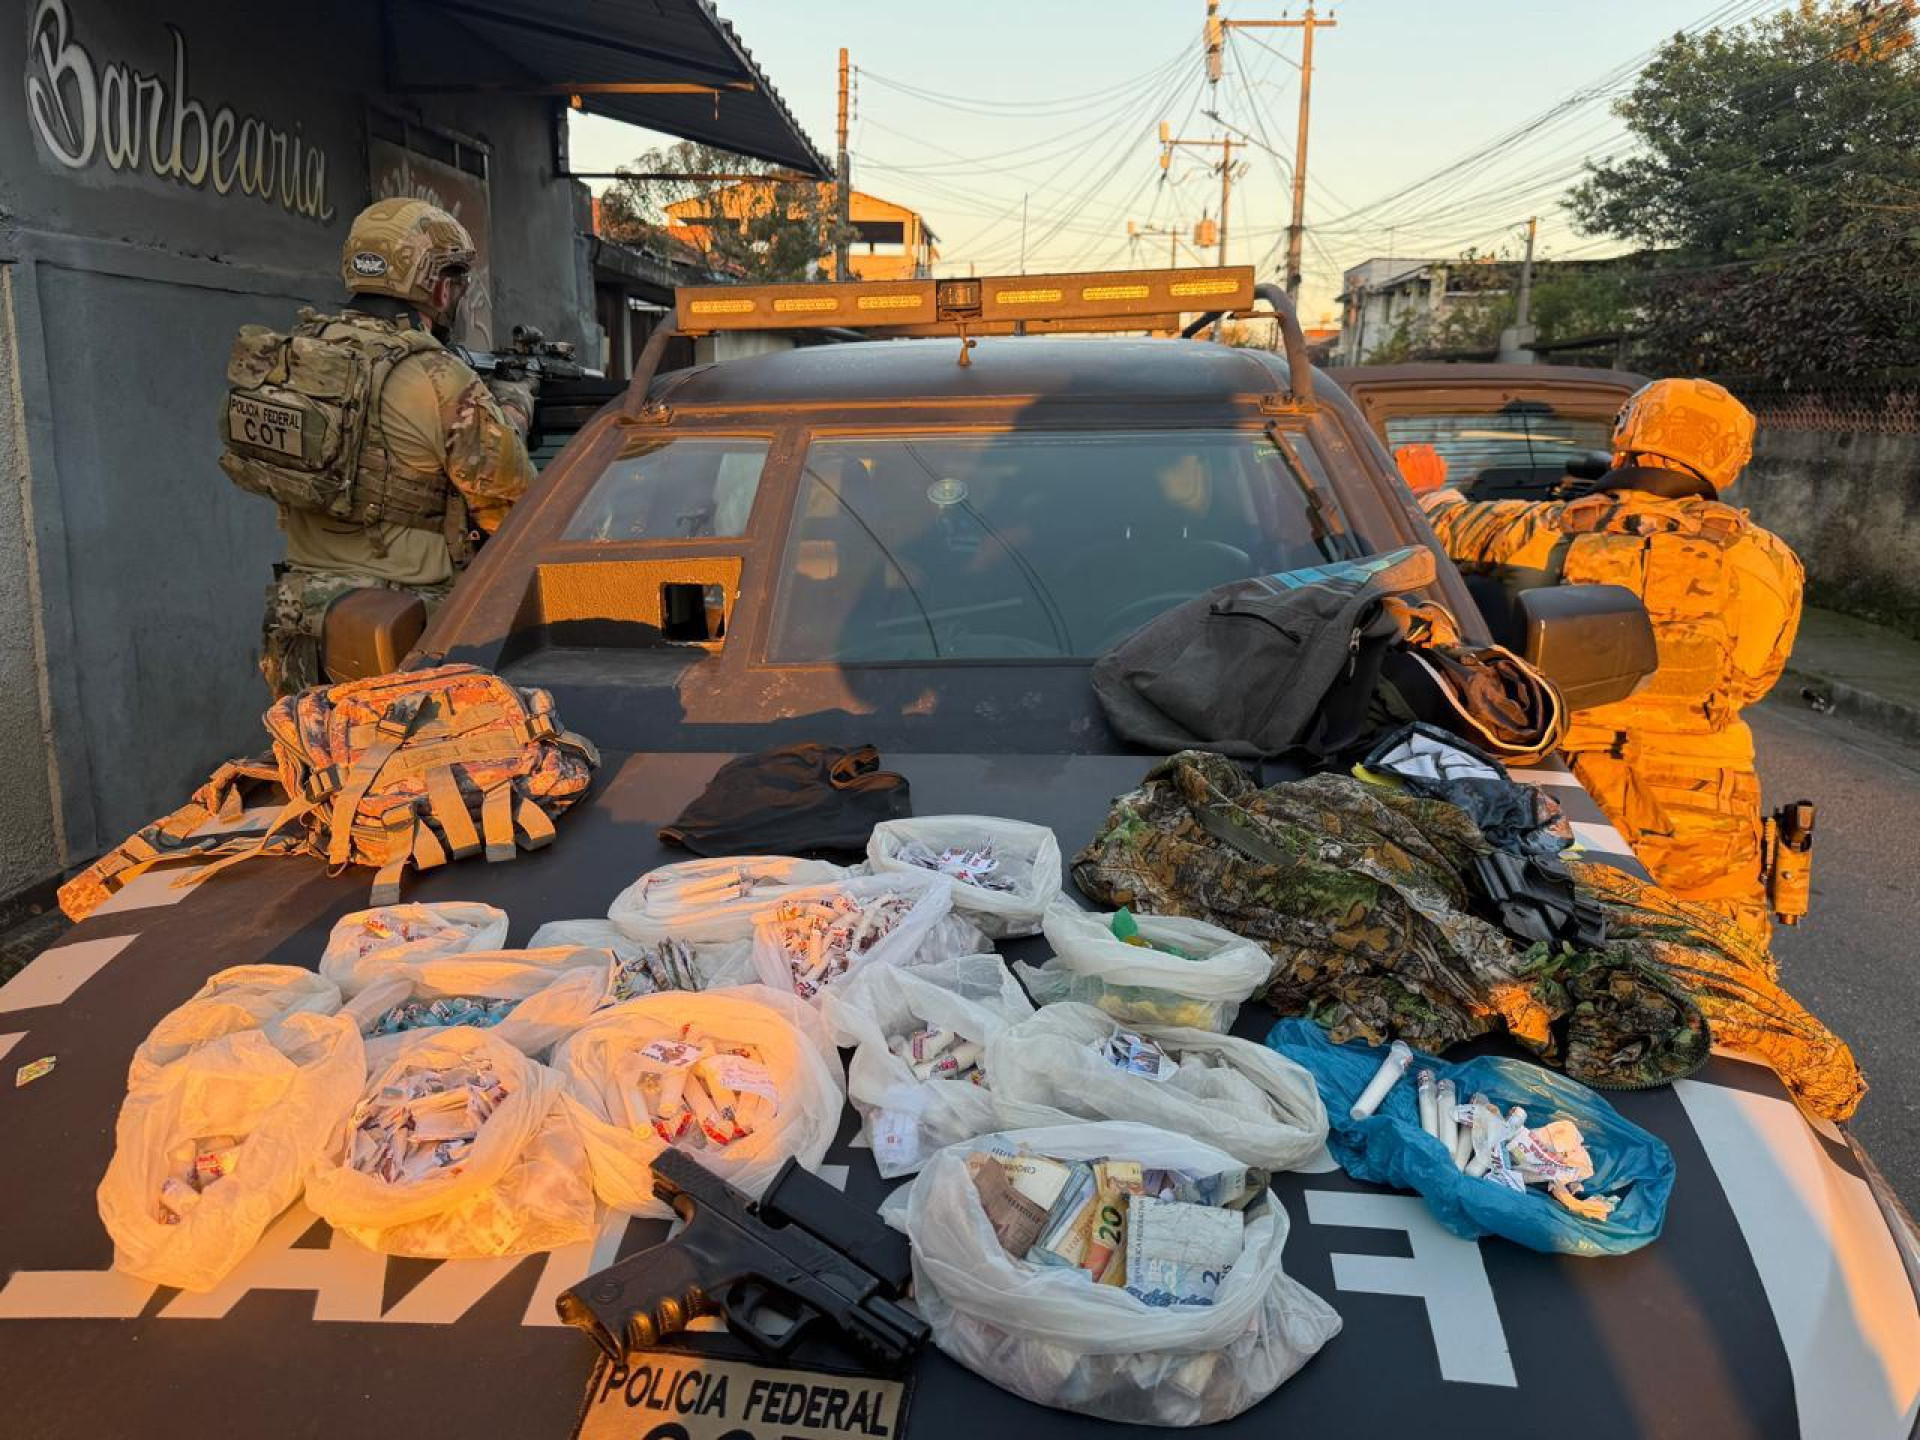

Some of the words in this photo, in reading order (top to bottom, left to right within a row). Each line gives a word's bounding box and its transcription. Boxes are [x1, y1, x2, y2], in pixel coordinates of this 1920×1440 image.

[28, 0, 334, 221] Barbearia
[244, 417, 288, 450] COT
[263, 407, 300, 430] FEDERAL
[1098, 1205, 1123, 1246] 20
[1202, 1270, 1220, 1286] 2
[599, 1364, 730, 1419] POLICIA
[743, 1379, 890, 1436] FEDERAL
